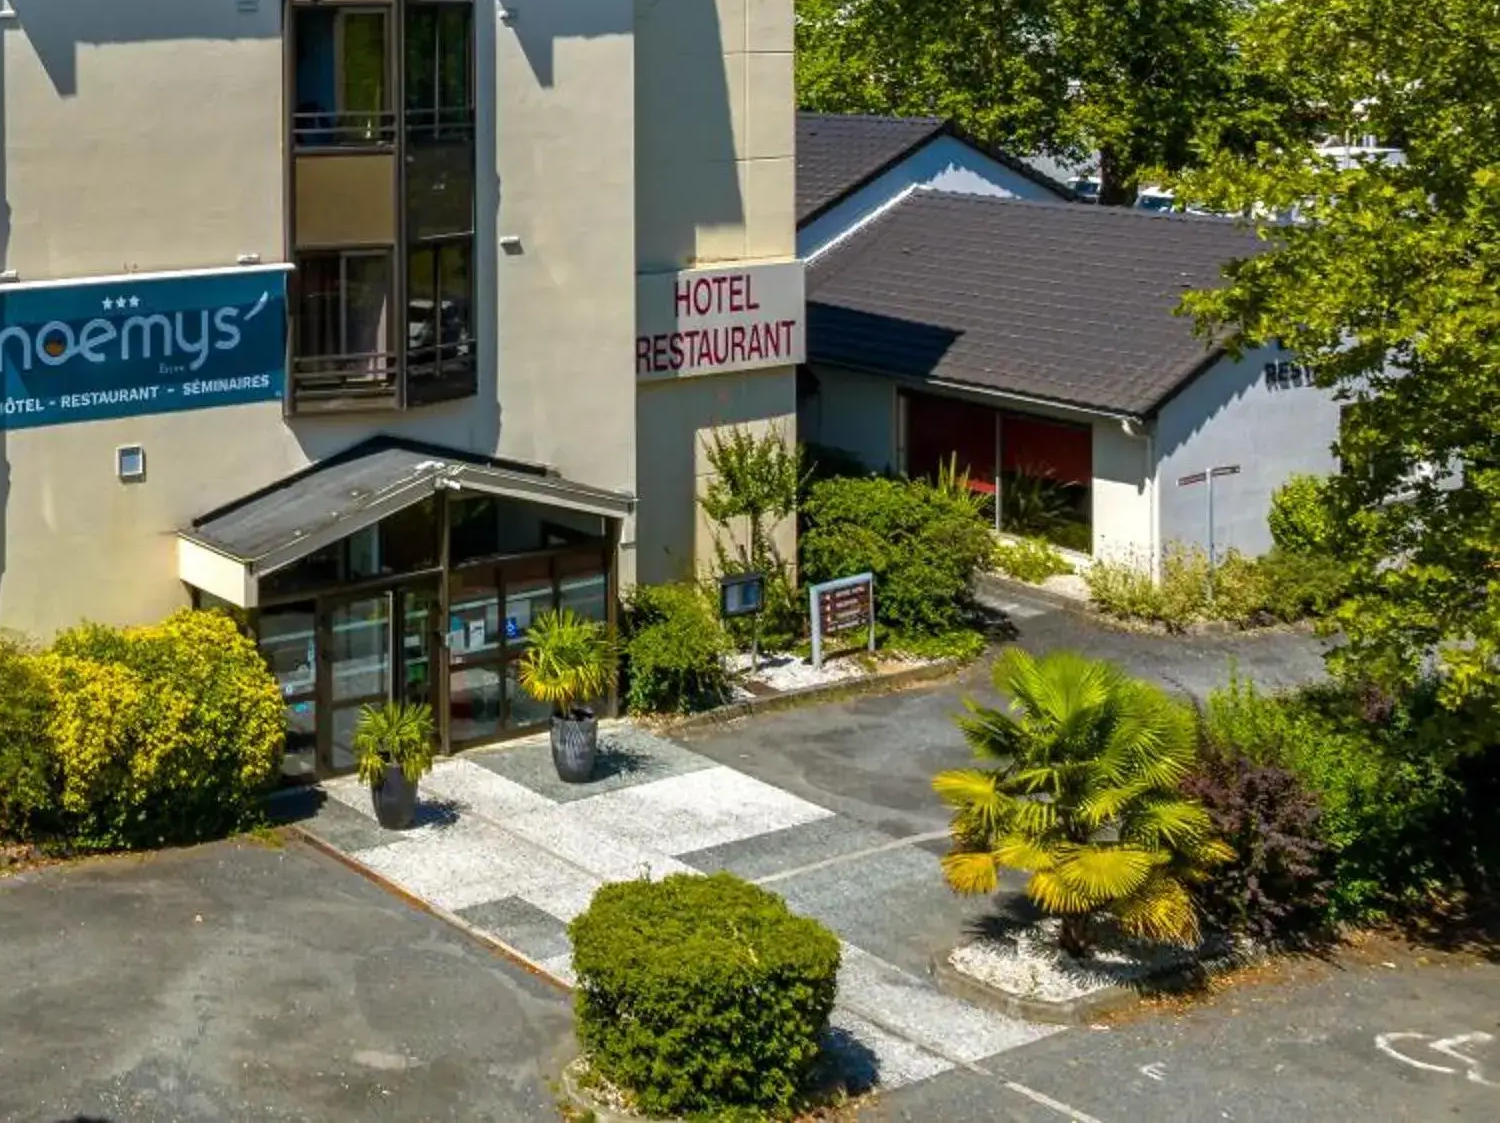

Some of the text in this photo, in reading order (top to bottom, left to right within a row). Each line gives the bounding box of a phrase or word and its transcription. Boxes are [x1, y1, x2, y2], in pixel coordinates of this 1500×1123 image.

[674, 274, 760, 317] HOTEL
[636, 320, 796, 374] RESTAURANT
[60, 386, 159, 409] RESTAURANT
[182, 375, 269, 396] SÉMINAIRES
